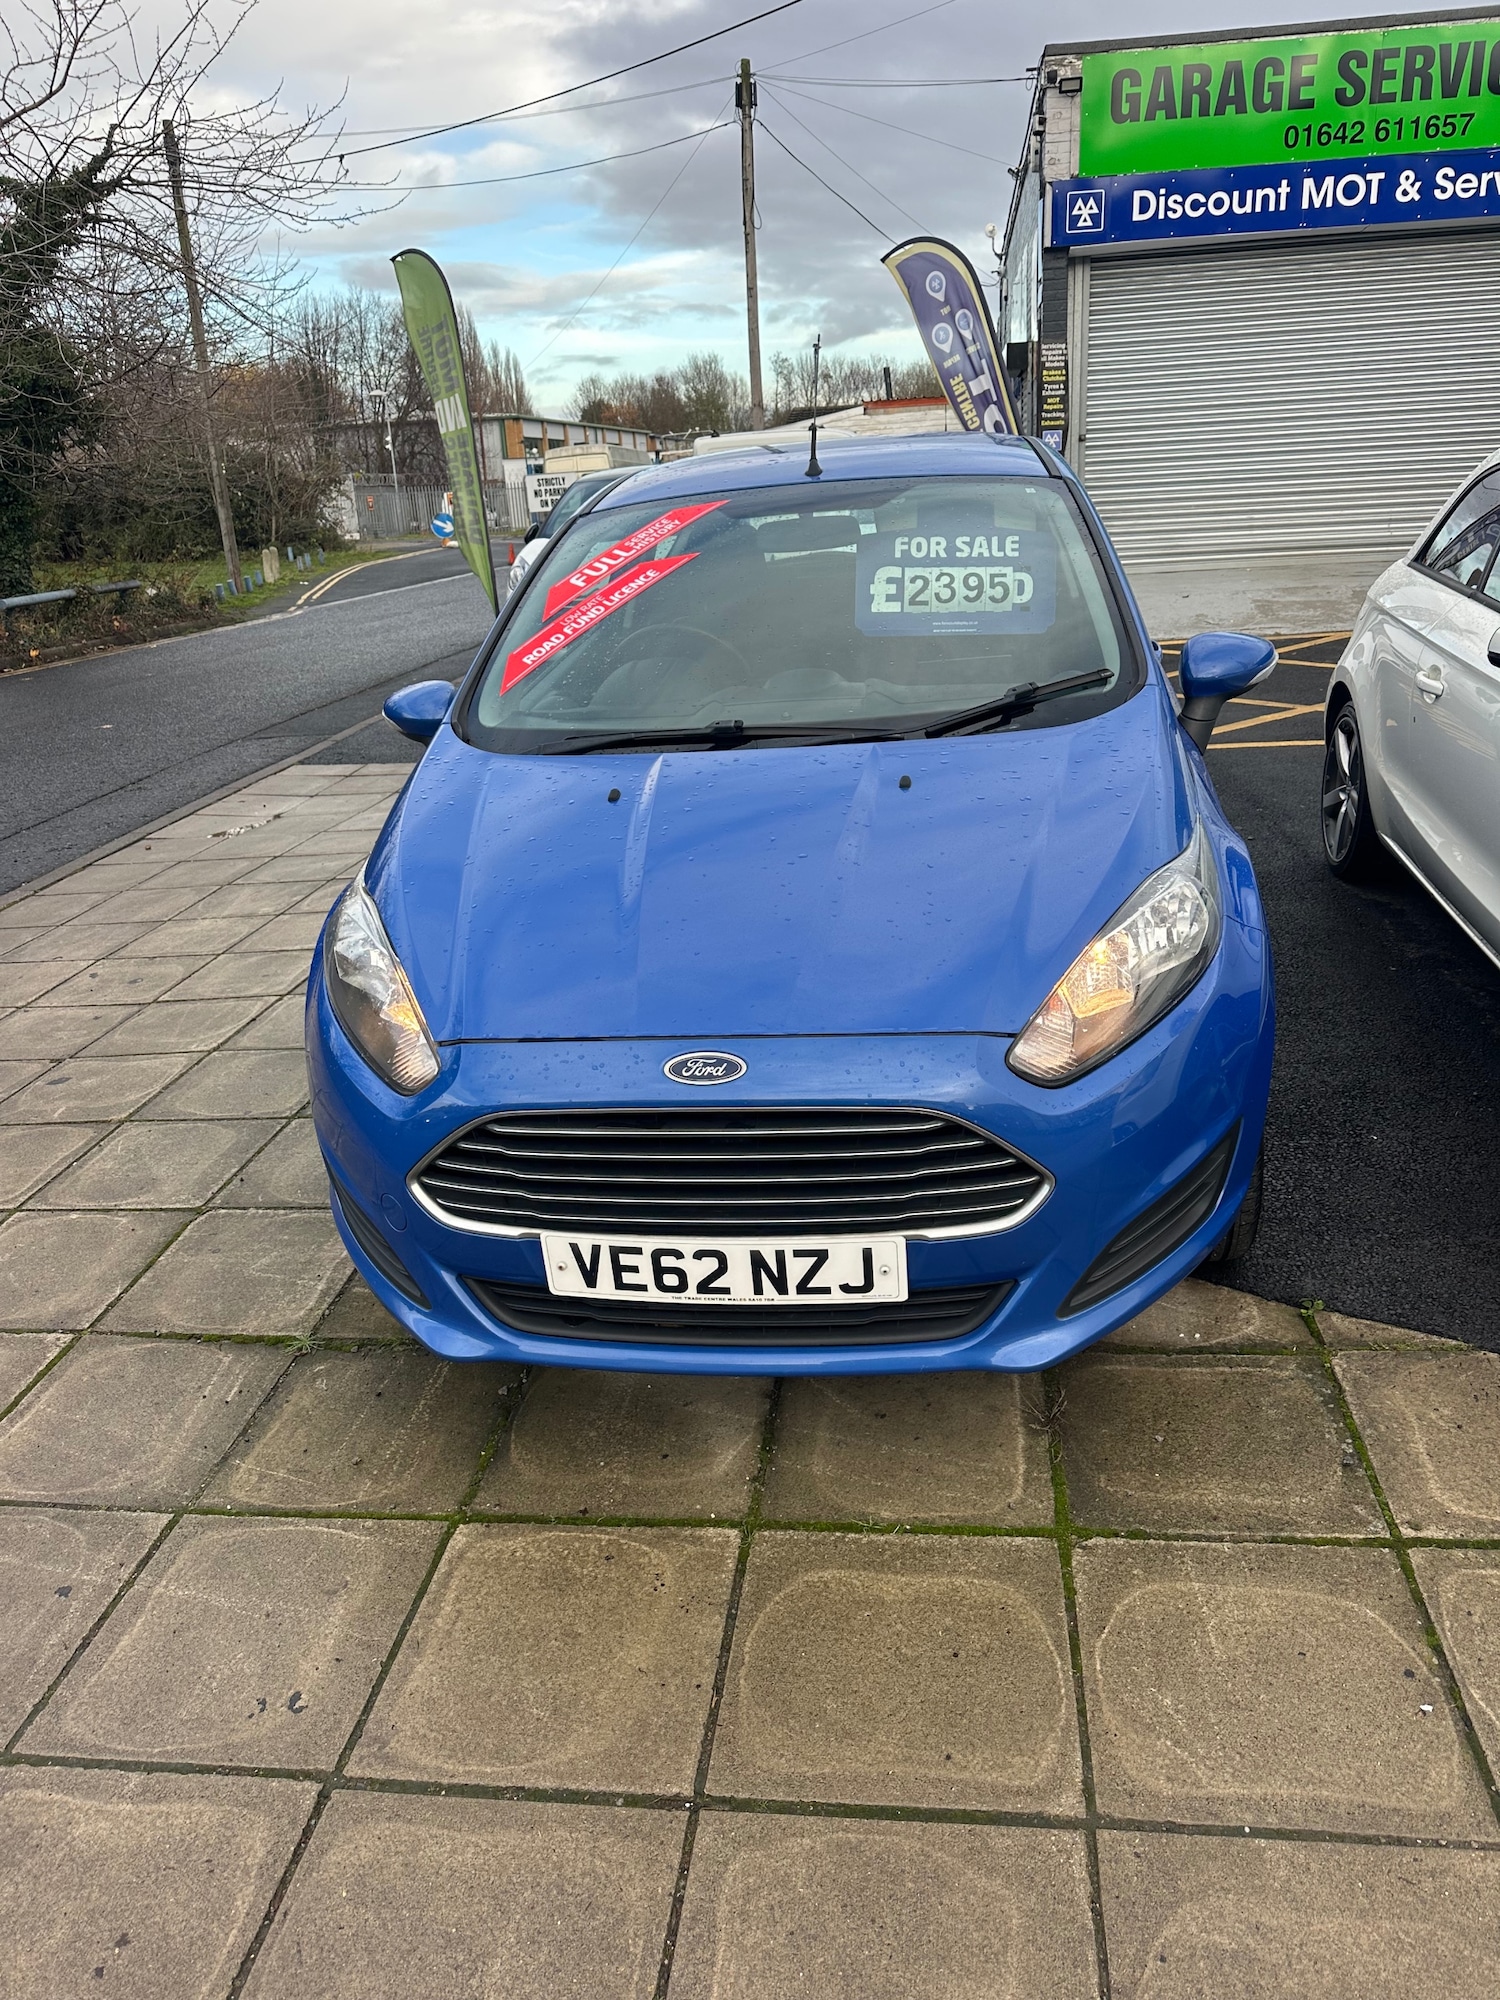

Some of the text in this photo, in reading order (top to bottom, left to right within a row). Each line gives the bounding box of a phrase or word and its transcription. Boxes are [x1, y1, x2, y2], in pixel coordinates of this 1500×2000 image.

[1110, 55, 1318, 125] GARAGE
[1284, 112, 1476, 149] 01642 611657
[1131, 179, 1290, 222] Discount
[1301, 172, 1385, 210] MOT
[1395, 169, 1421, 202] &
[534, 488, 567, 498] NO PARKIN
[537, 476, 566, 487] STRICTLY
[540, 499, 549, 508] ON
[634, 519, 681, 550] HISTORY
[895, 535, 1020, 558] FOR SALE
[570, 518, 672, 587] FULL SERVICE
[522, 569, 660, 665] ROAD FUND LICENCE
[560, 595, 606, 626] LOW RATE
[682, 1058, 728, 1076] Ford
[568, 1242, 874, 1296] VE62 NZJ
